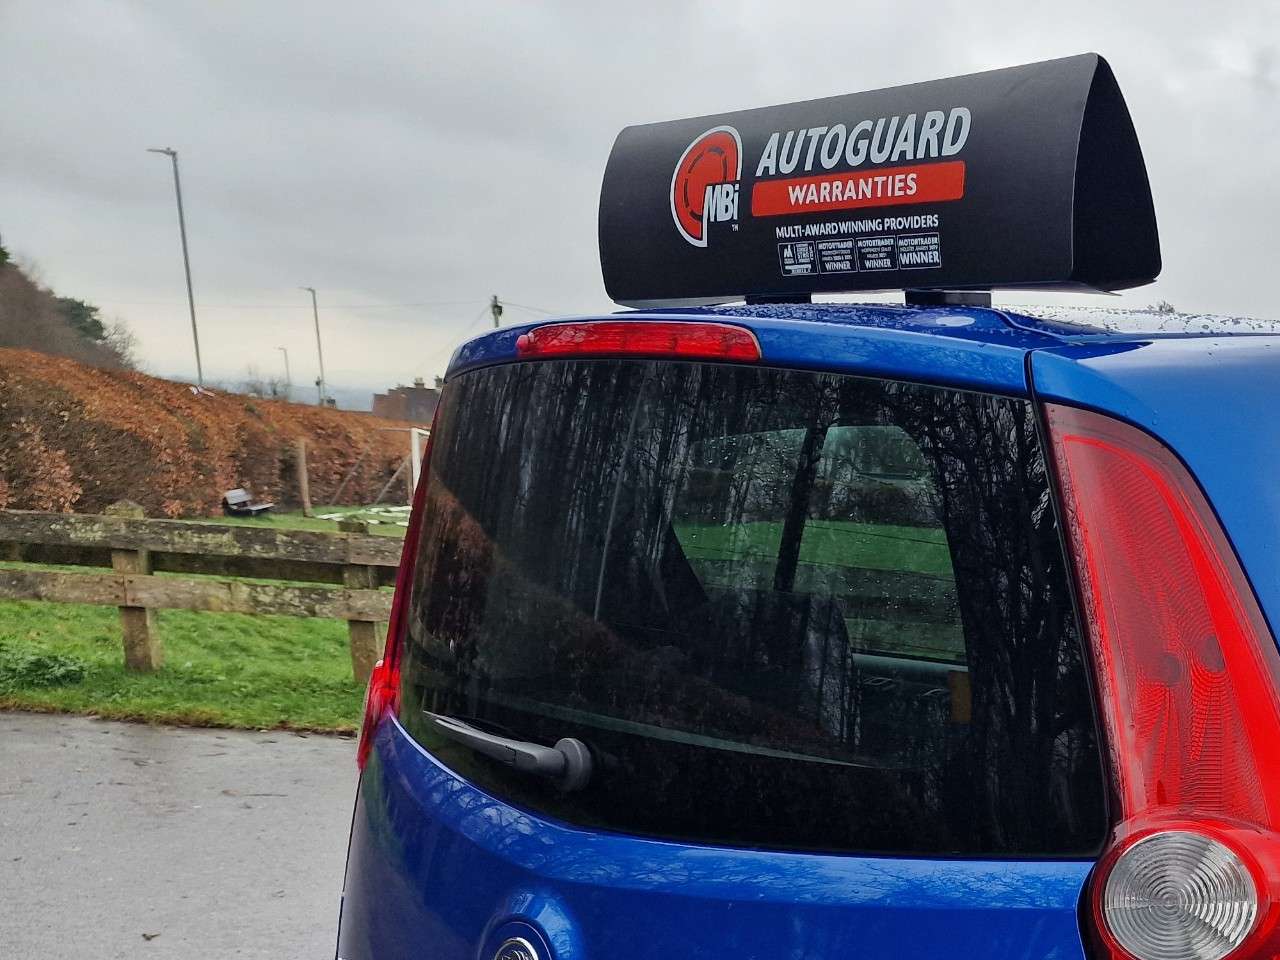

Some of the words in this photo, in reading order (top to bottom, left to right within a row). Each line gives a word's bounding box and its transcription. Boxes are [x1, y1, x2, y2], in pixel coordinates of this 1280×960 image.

[755, 107, 971, 177] AUTOGUARD
[788, 173, 917, 205] WARRANTIES
[703, 183, 740, 222] MBi
[839, 218, 882, 234] WINNING
[884, 214, 939, 229] PROVIDERS
[825, 260, 851, 271] WINNER
[865, 258, 892, 269] WINNER
[900, 251, 940, 265] WINNER
